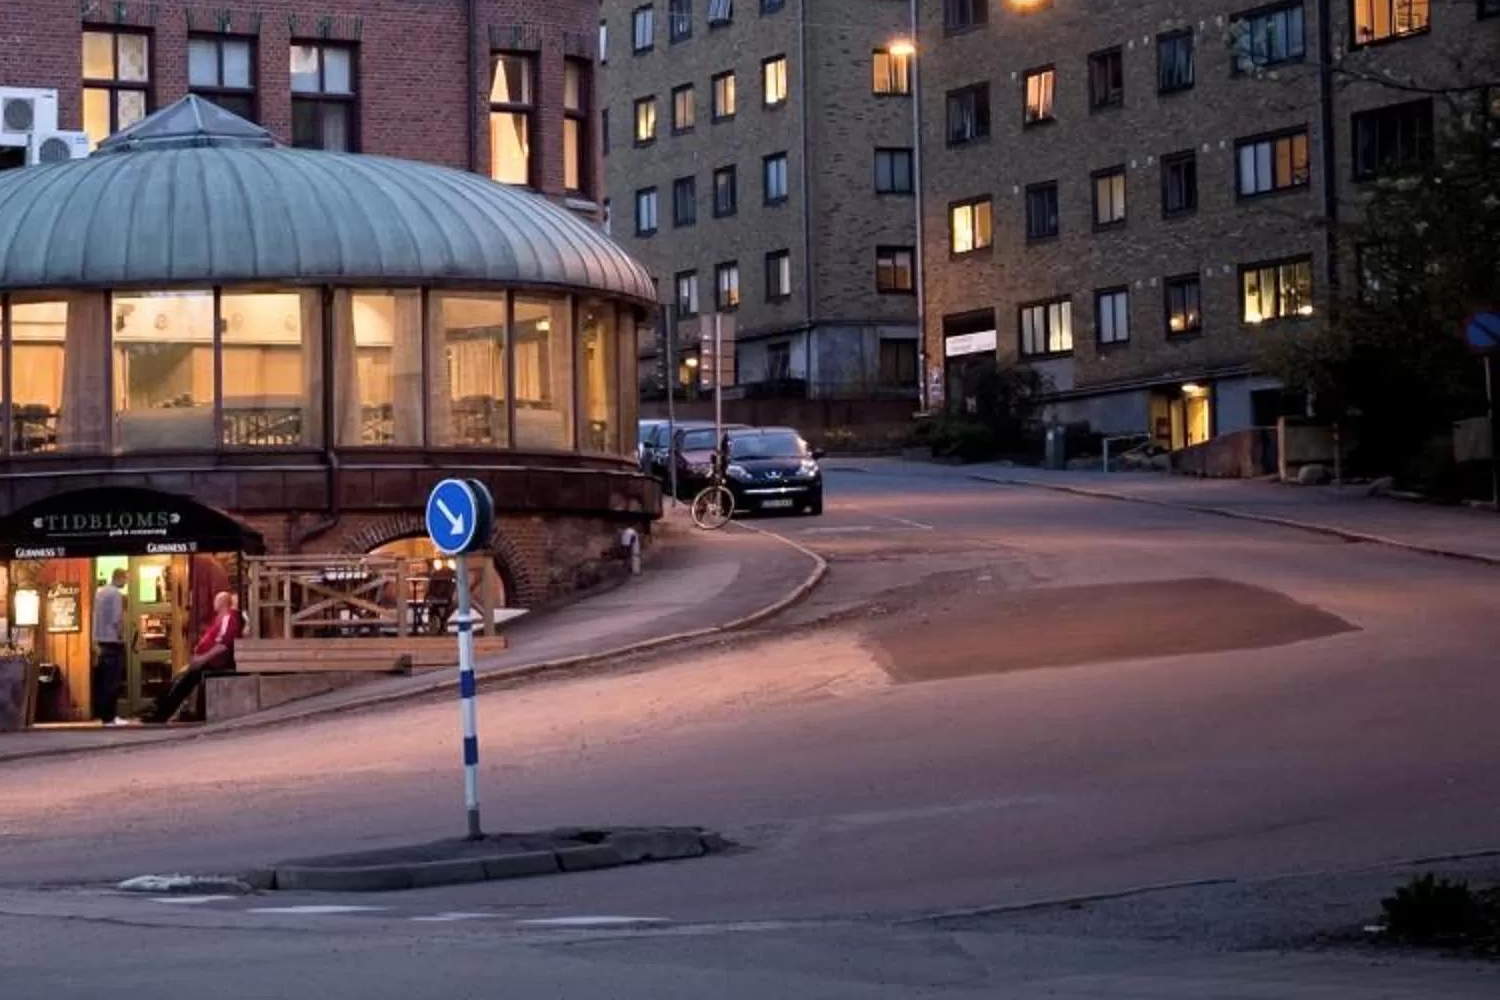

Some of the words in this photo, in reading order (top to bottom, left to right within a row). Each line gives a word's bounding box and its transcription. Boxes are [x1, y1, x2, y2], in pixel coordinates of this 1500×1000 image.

[46, 512, 169, 531] TIDBLOMS
[15, 547, 55, 558] GUINNESS
[147, 542, 186, 553] GUINNESS
